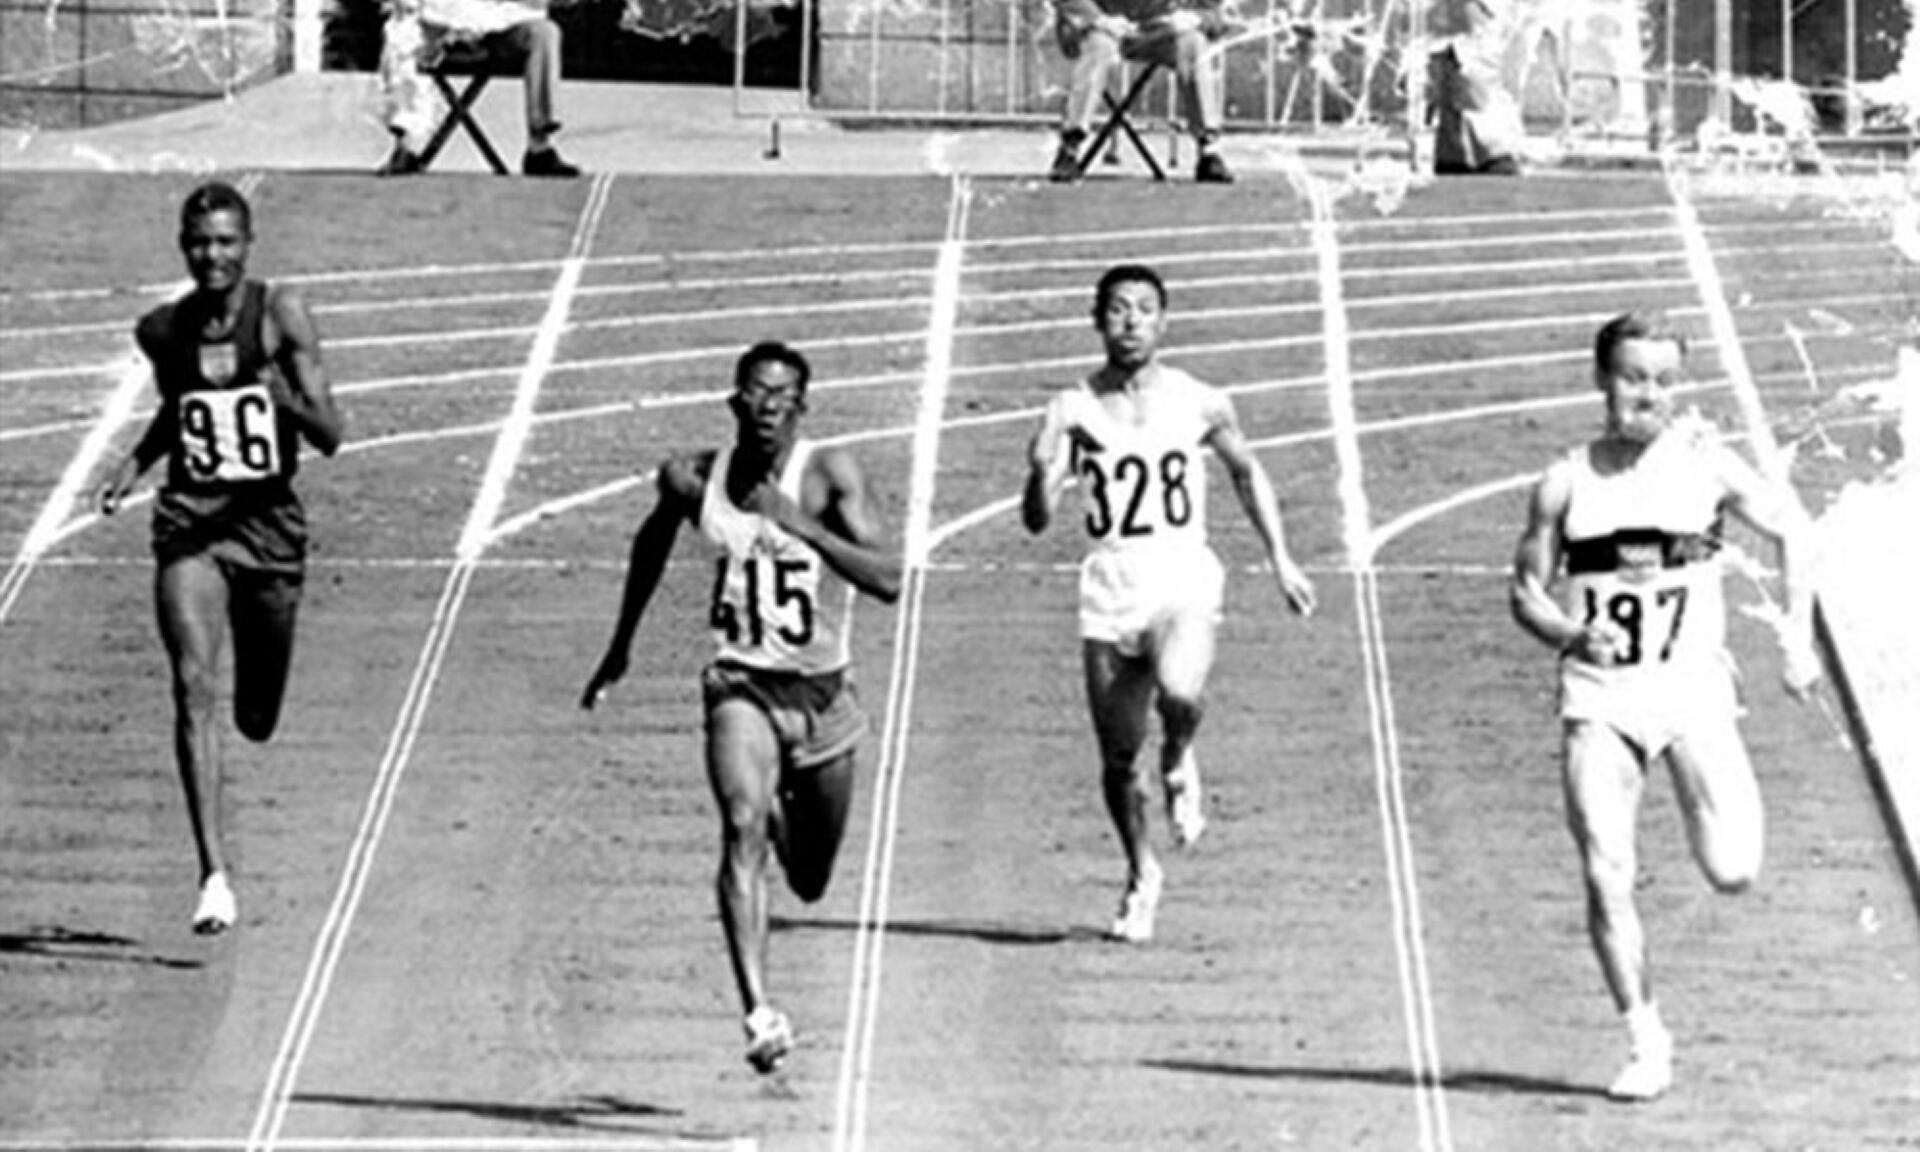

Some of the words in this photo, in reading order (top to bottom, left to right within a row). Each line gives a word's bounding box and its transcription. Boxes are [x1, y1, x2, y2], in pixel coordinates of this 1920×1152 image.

[184, 394, 271, 476] 96
[1081, 450, 1191, 539] 328
[710, 556, 813, 646] 415
